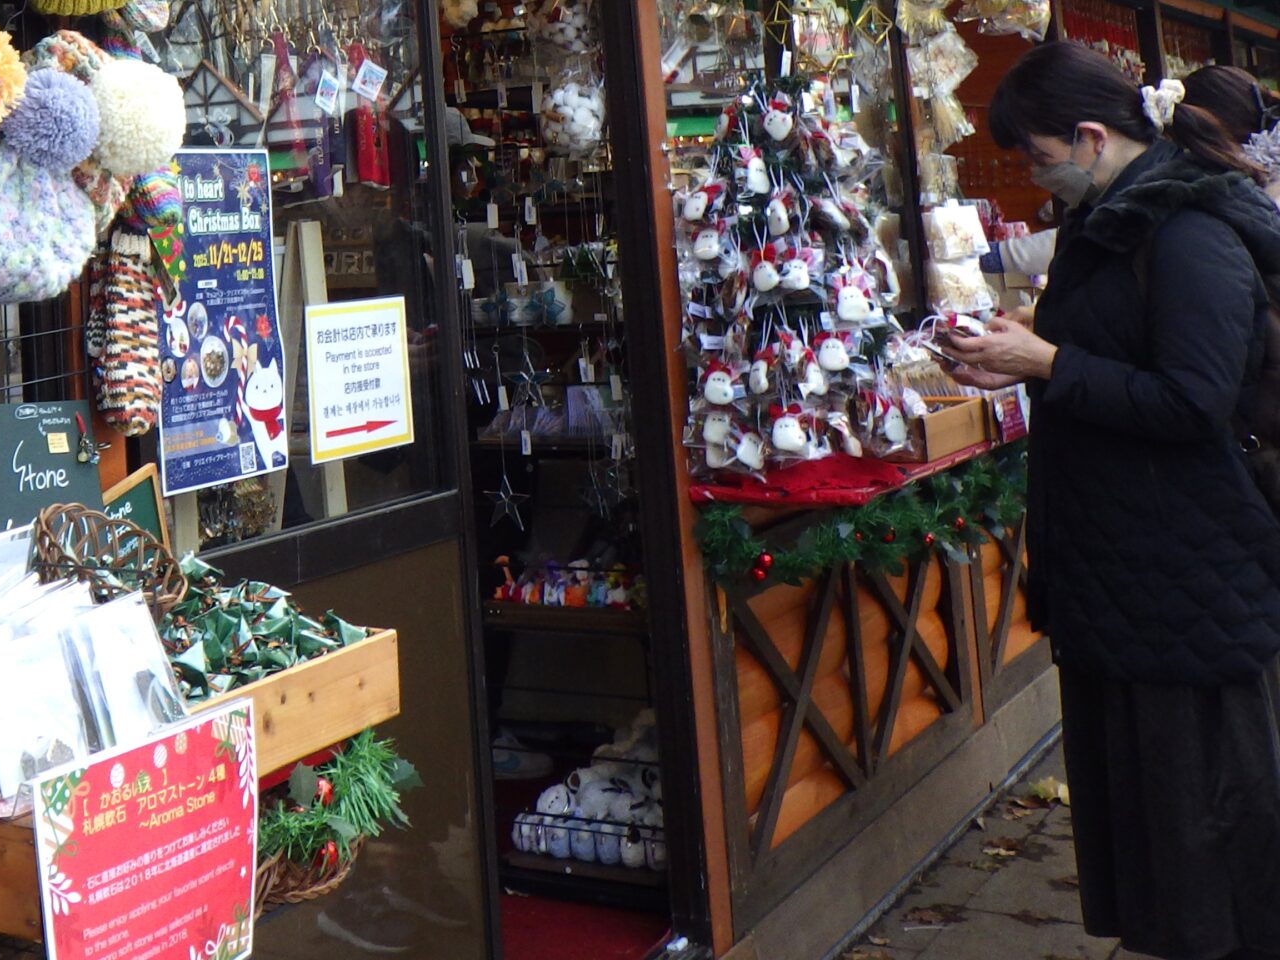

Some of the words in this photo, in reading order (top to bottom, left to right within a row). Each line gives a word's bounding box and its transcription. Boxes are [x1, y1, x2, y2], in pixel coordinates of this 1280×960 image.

[184, 179, 195, 200] to
[197, 175, 224, 200] heart
[188, 207, 239, 234] Christmas
[241, 206, 261, 231] Box
[317, 322, 397, 345] お会計は店内で承ります
[325, 350, 356, 363] Payment
[358, 348, 363, 358] is
[365, 344, 392, 358] accepted
[343, 364, 349, 374] in
[351, 363, 362, 373] the
[363, 361, 380, 372] store
[12, 440, 70, 492] Stone
[186, 791, 216, 813] Stone
[83, 923, 108, 940] Please
[133, 933, 154, 950] stone
[168, 908, 195, 932] selected
[84, 946, 93, 957] to
[94, 939, 108, 952] the
